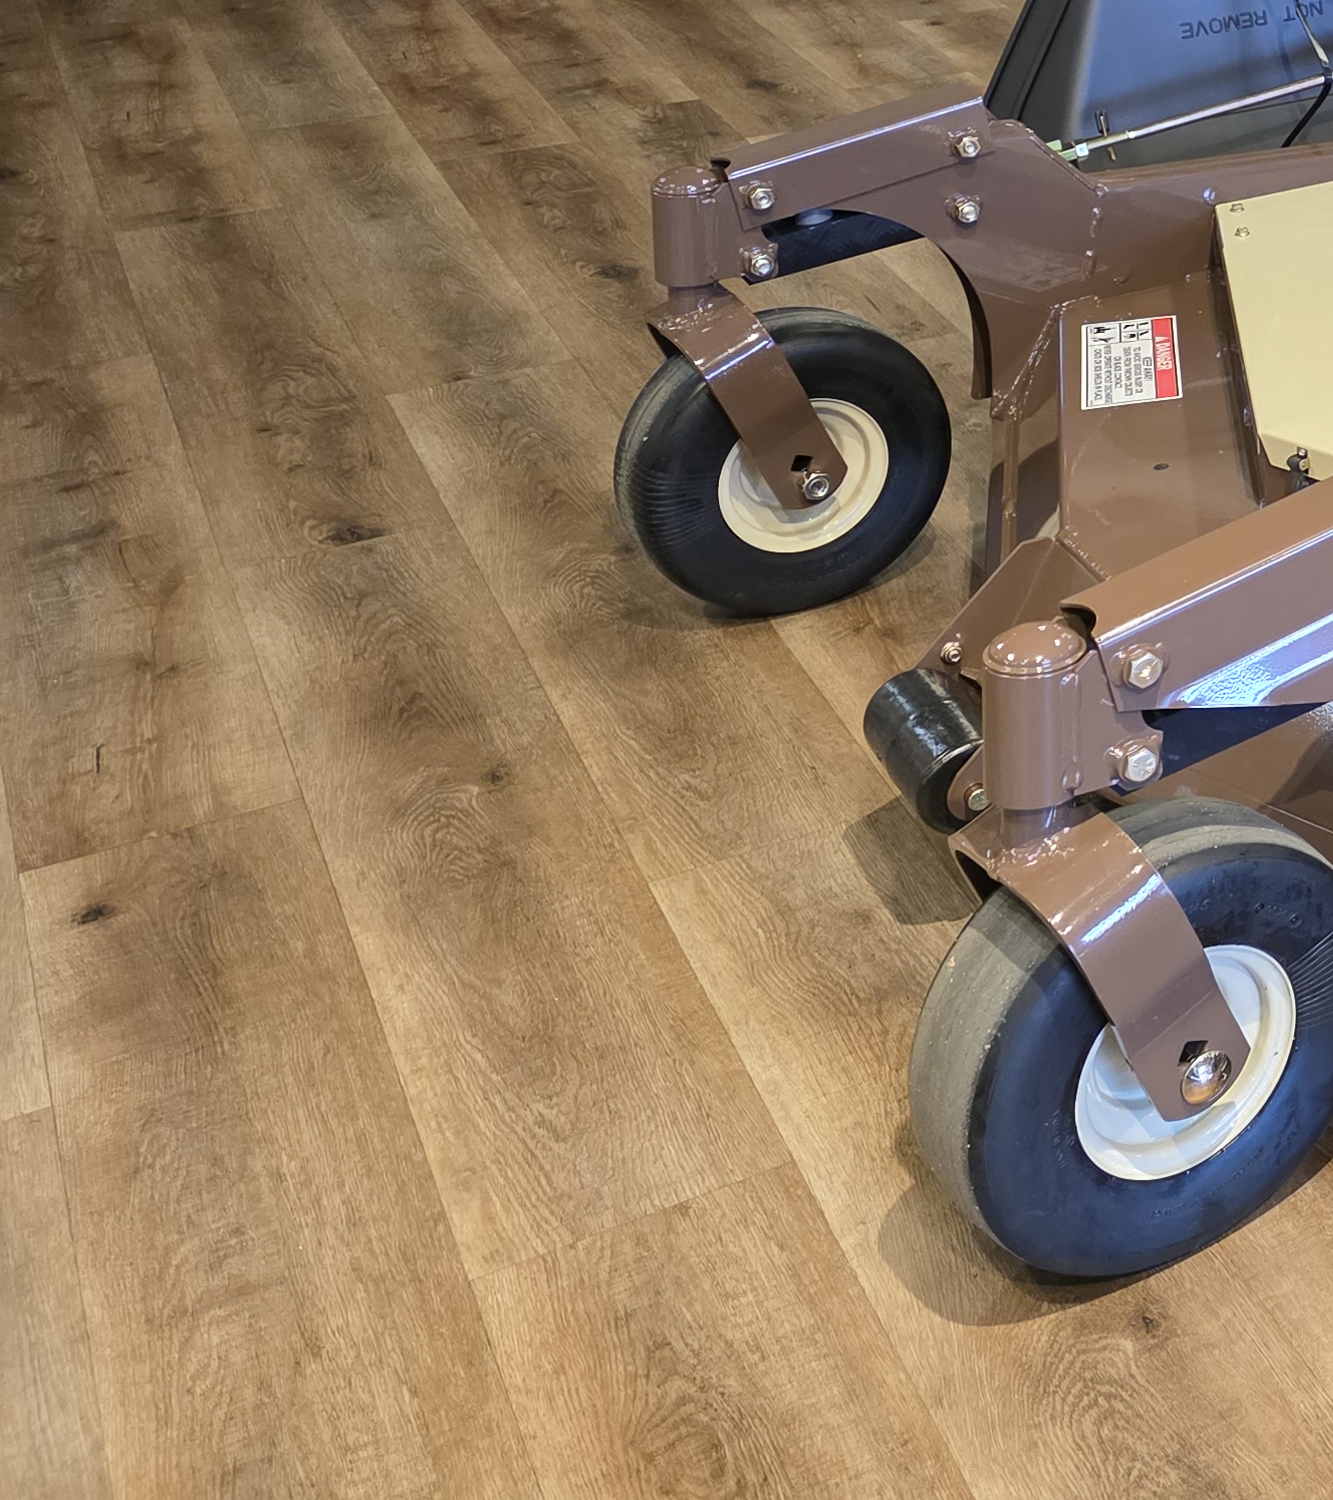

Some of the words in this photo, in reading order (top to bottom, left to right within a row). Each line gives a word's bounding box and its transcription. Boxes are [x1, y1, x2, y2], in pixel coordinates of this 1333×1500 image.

[1181, 9, 1268, 40] REMOVE
[1282, 1, 1325, 24] NOT
[1155, 342, 1173, 371] DANGER
